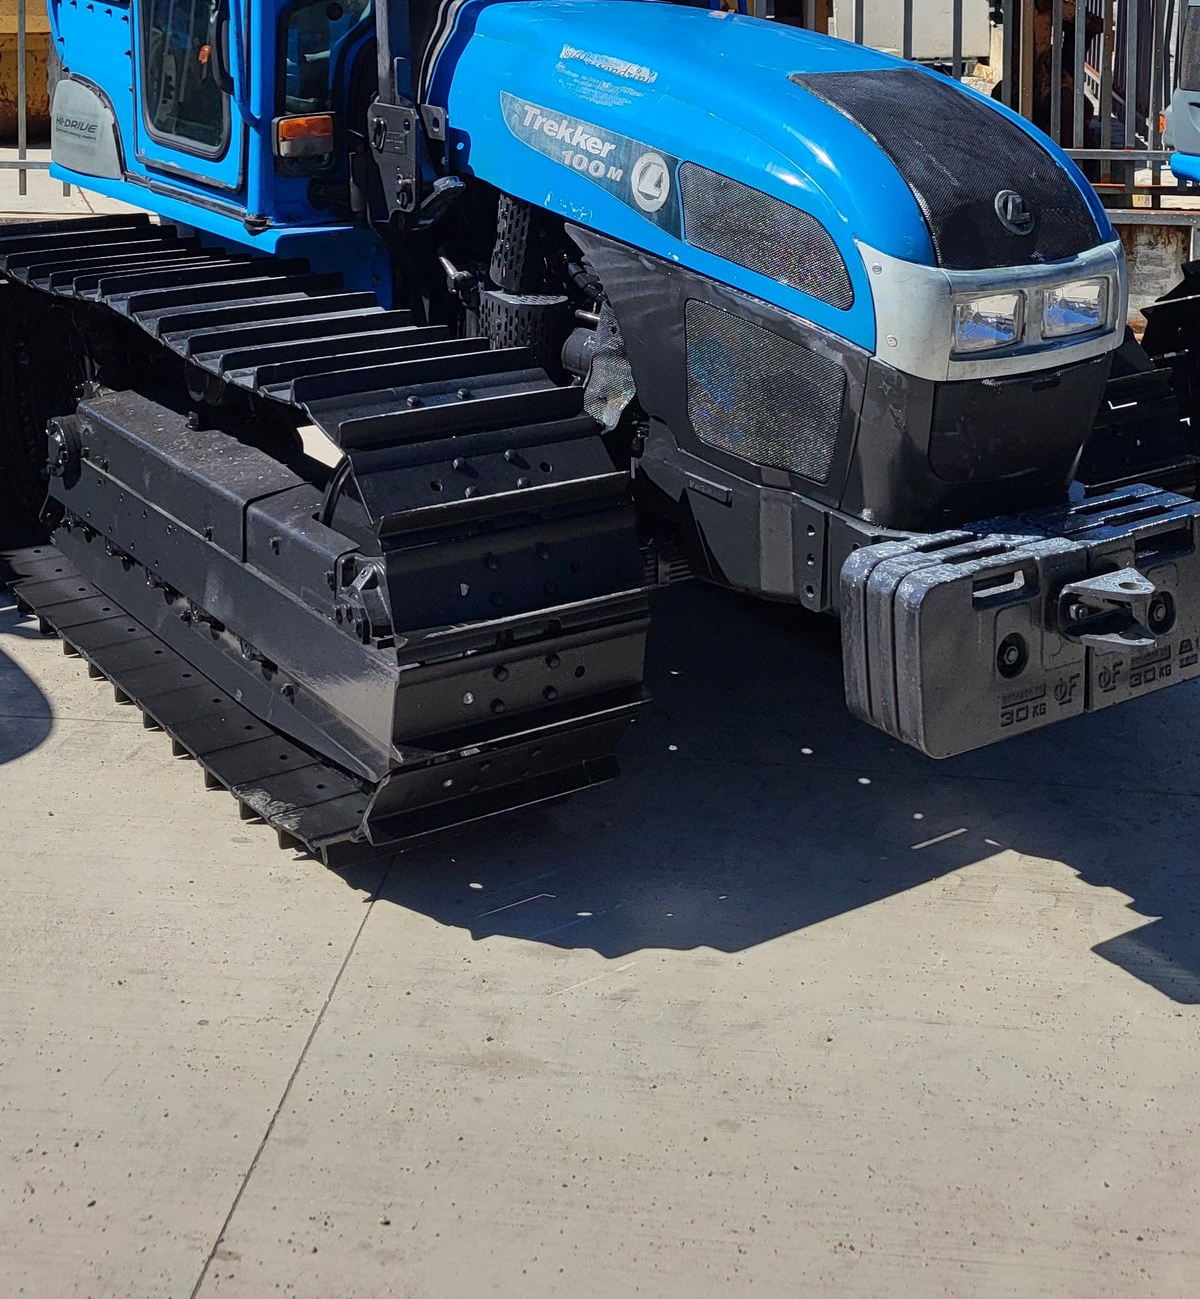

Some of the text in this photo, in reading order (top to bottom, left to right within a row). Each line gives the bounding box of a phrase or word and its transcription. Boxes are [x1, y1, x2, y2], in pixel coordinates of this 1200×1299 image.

[523, 105, 616, 158] Trekker
[1129, 666, 1156, 688] 30
[1001, 702, 1047, 727] 30 KG
